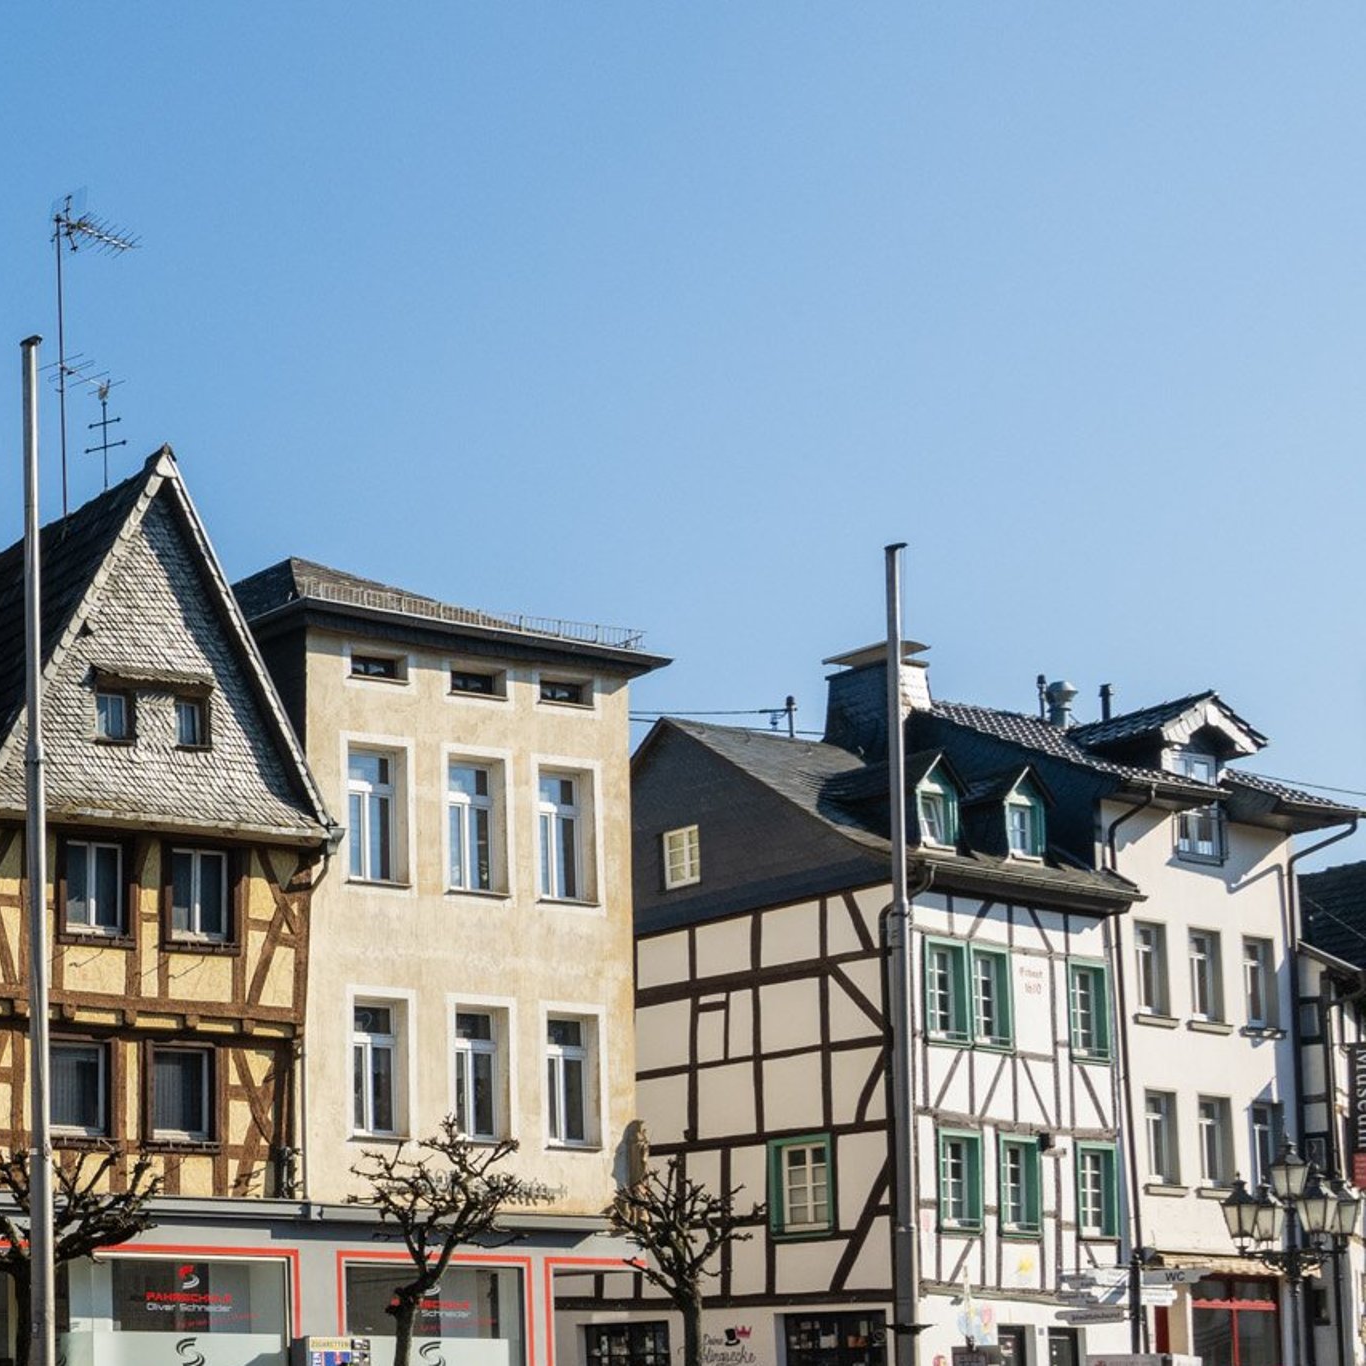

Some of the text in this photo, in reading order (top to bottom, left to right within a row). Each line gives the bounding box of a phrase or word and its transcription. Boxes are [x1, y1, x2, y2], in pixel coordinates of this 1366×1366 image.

[1165, 1272, 1185, 1282] WC
[145, 1303, 232, 1312] Oliver Schneider
